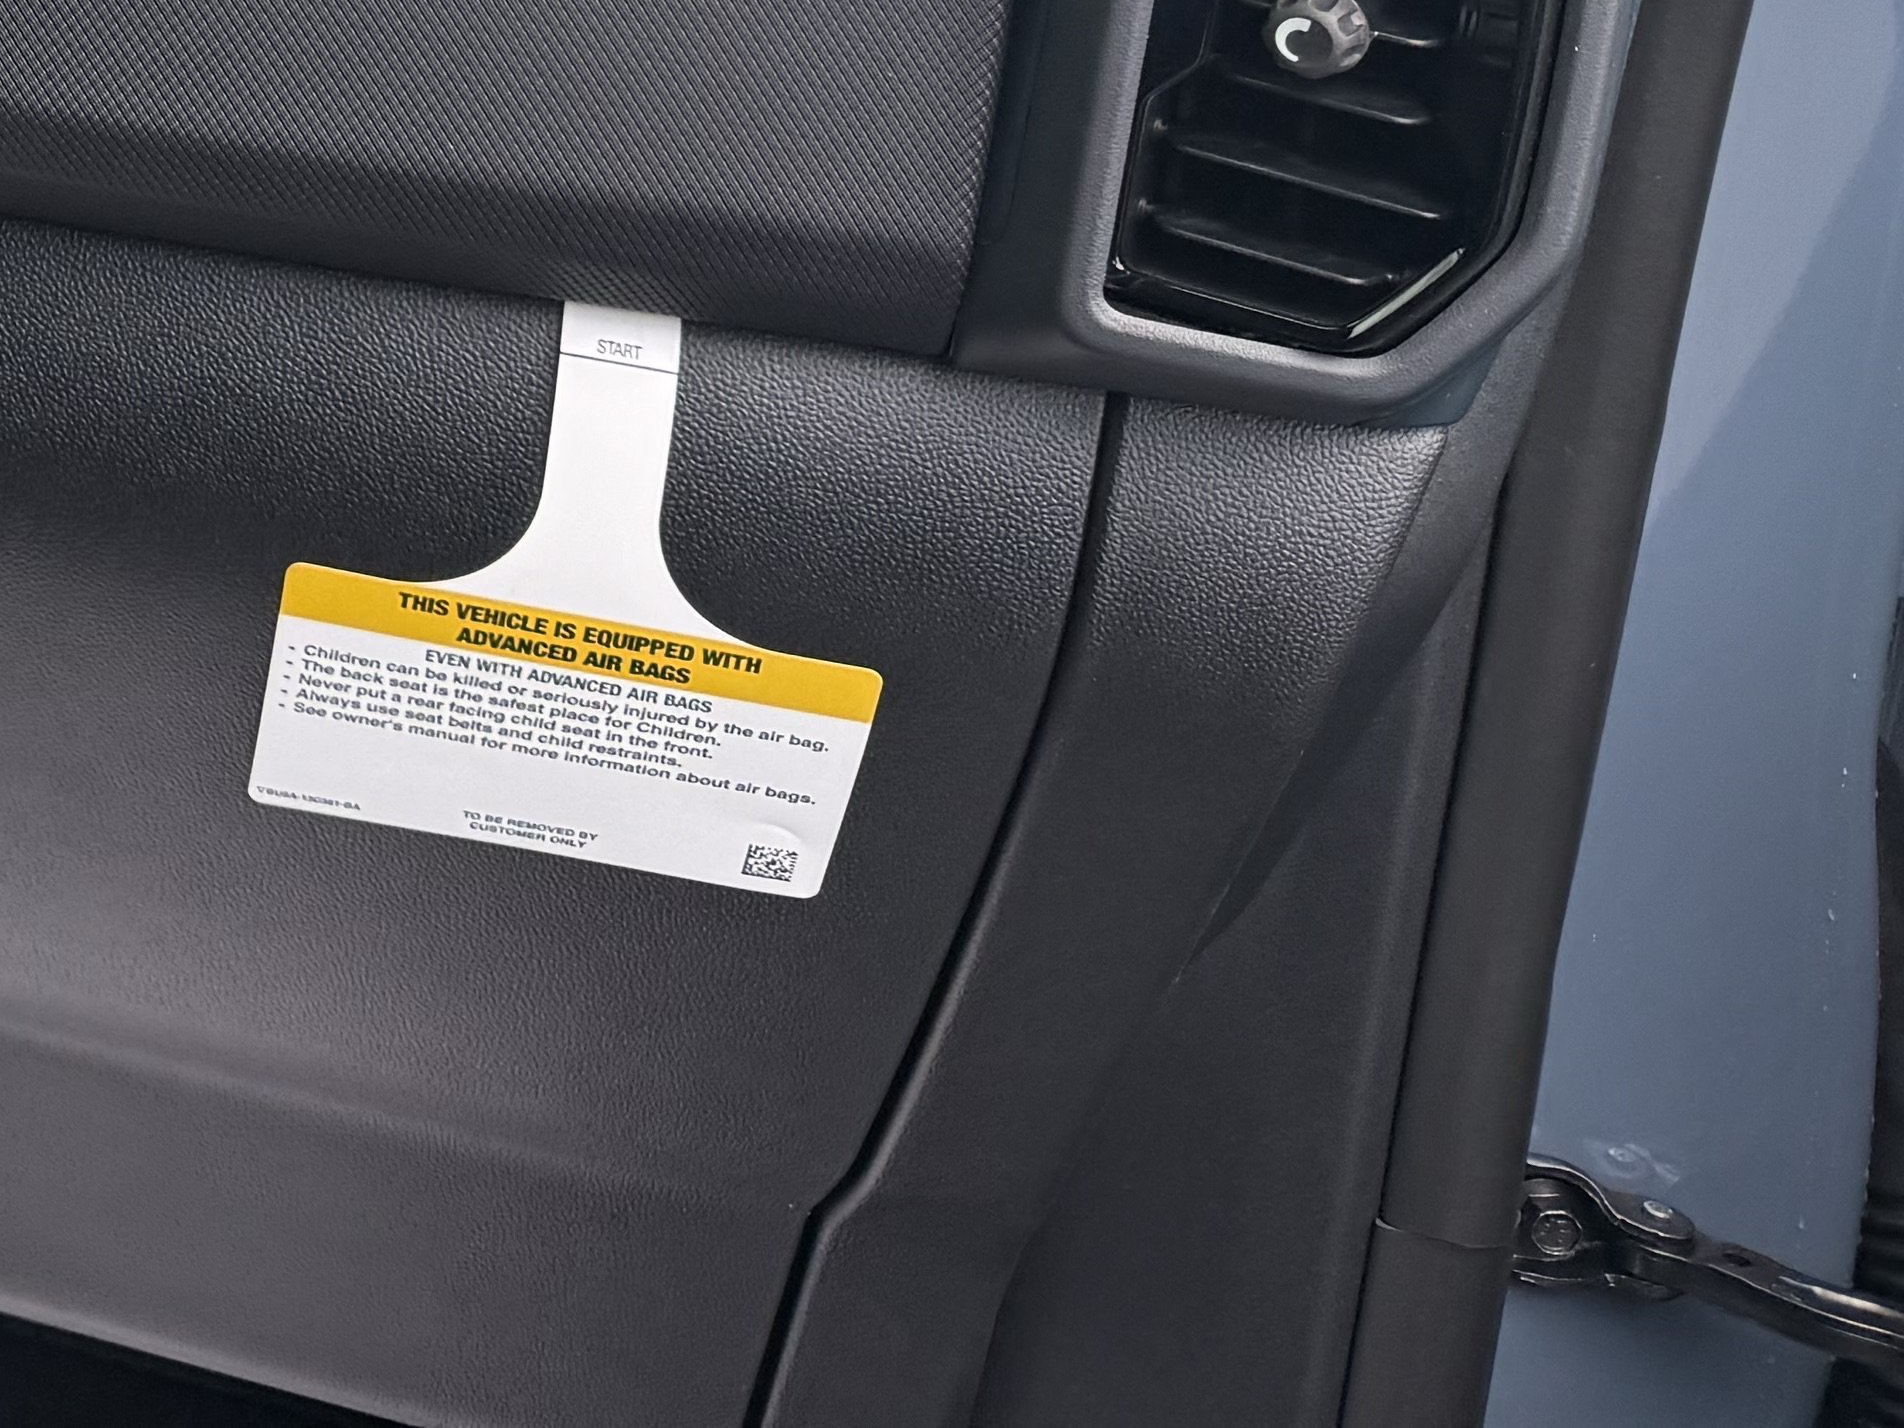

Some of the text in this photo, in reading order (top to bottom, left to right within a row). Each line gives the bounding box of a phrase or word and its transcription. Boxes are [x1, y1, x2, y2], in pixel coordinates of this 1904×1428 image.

[597, 339, 643, 360] START
[399, 592, 762, 674] THIS VEHICLE IS EQUIPPED WITH
[456, 627, 691, 684] ADVANCED AIR BAGS
[298, 674, 713, 759] Never put a rear facing child seat in the front.
[302, 658, 721, 747] The back seat is the safest place for Children.
[304, 644, 829, 753] Children can be killed or seriously injured by the air bag.
[425, 649, 712, 713] EVEN WITH ADVANCED AIR BAGS
[294, 701, 816, 806] See owner's manual for more information about air bags.
[296, 688, 682, 768] Always use seat belts and child restraints.
[463, 810, 598, 841] TO BE REMOVED BY
[469, 821, 587, 848] CUSTOMER ONLY
